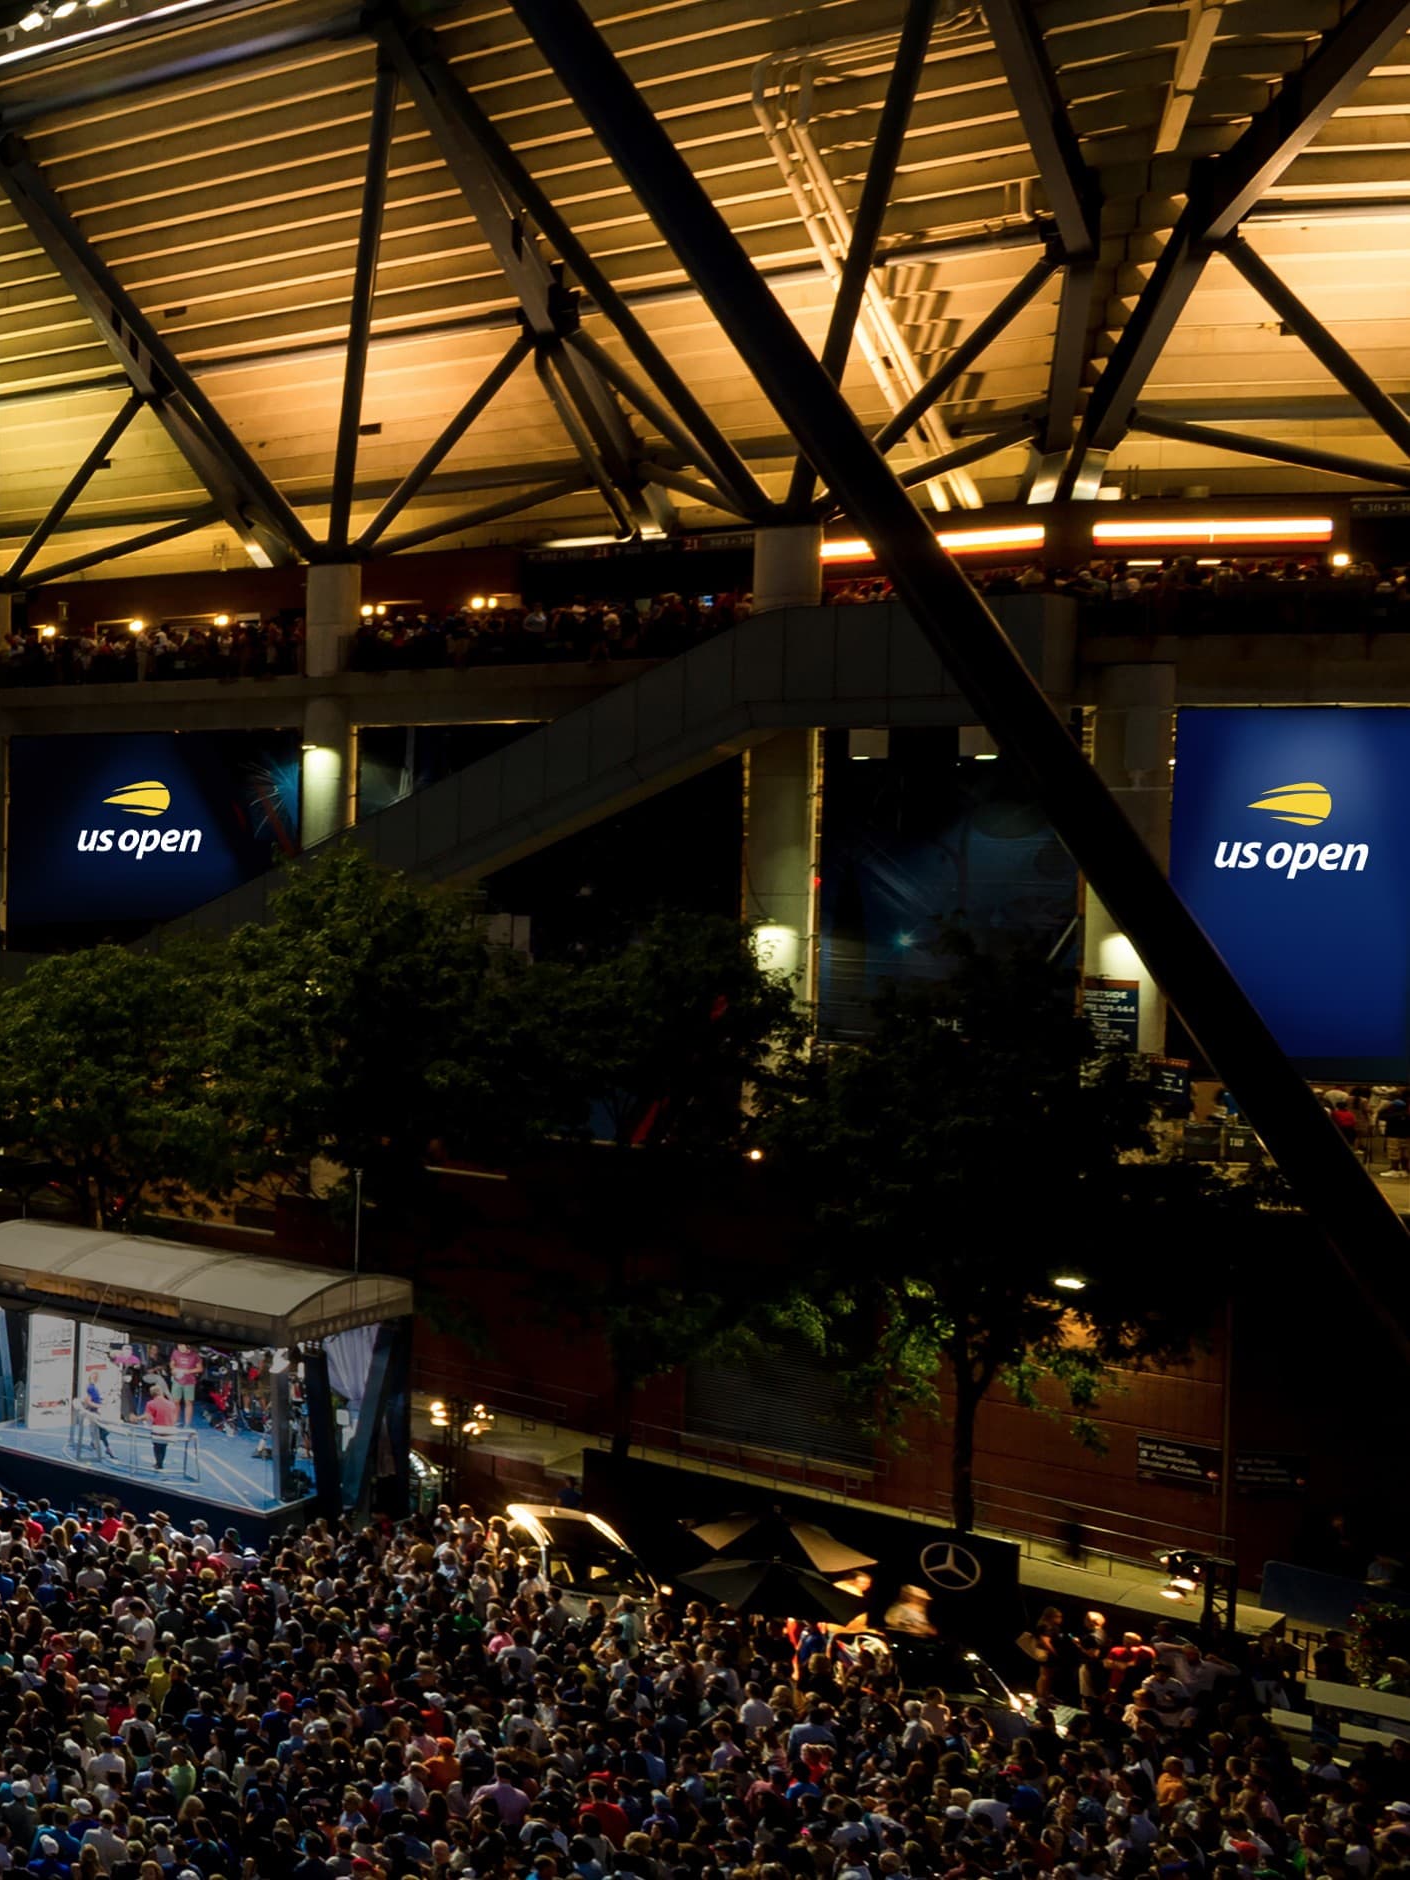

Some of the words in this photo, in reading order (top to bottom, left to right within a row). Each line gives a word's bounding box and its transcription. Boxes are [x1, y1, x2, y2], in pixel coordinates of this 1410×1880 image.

[77, 829, 115, 852] us
[118, 829, 202, 860] open
[1214, 841, 1262, 869] us
[1265, 842, 1369, 879] open
